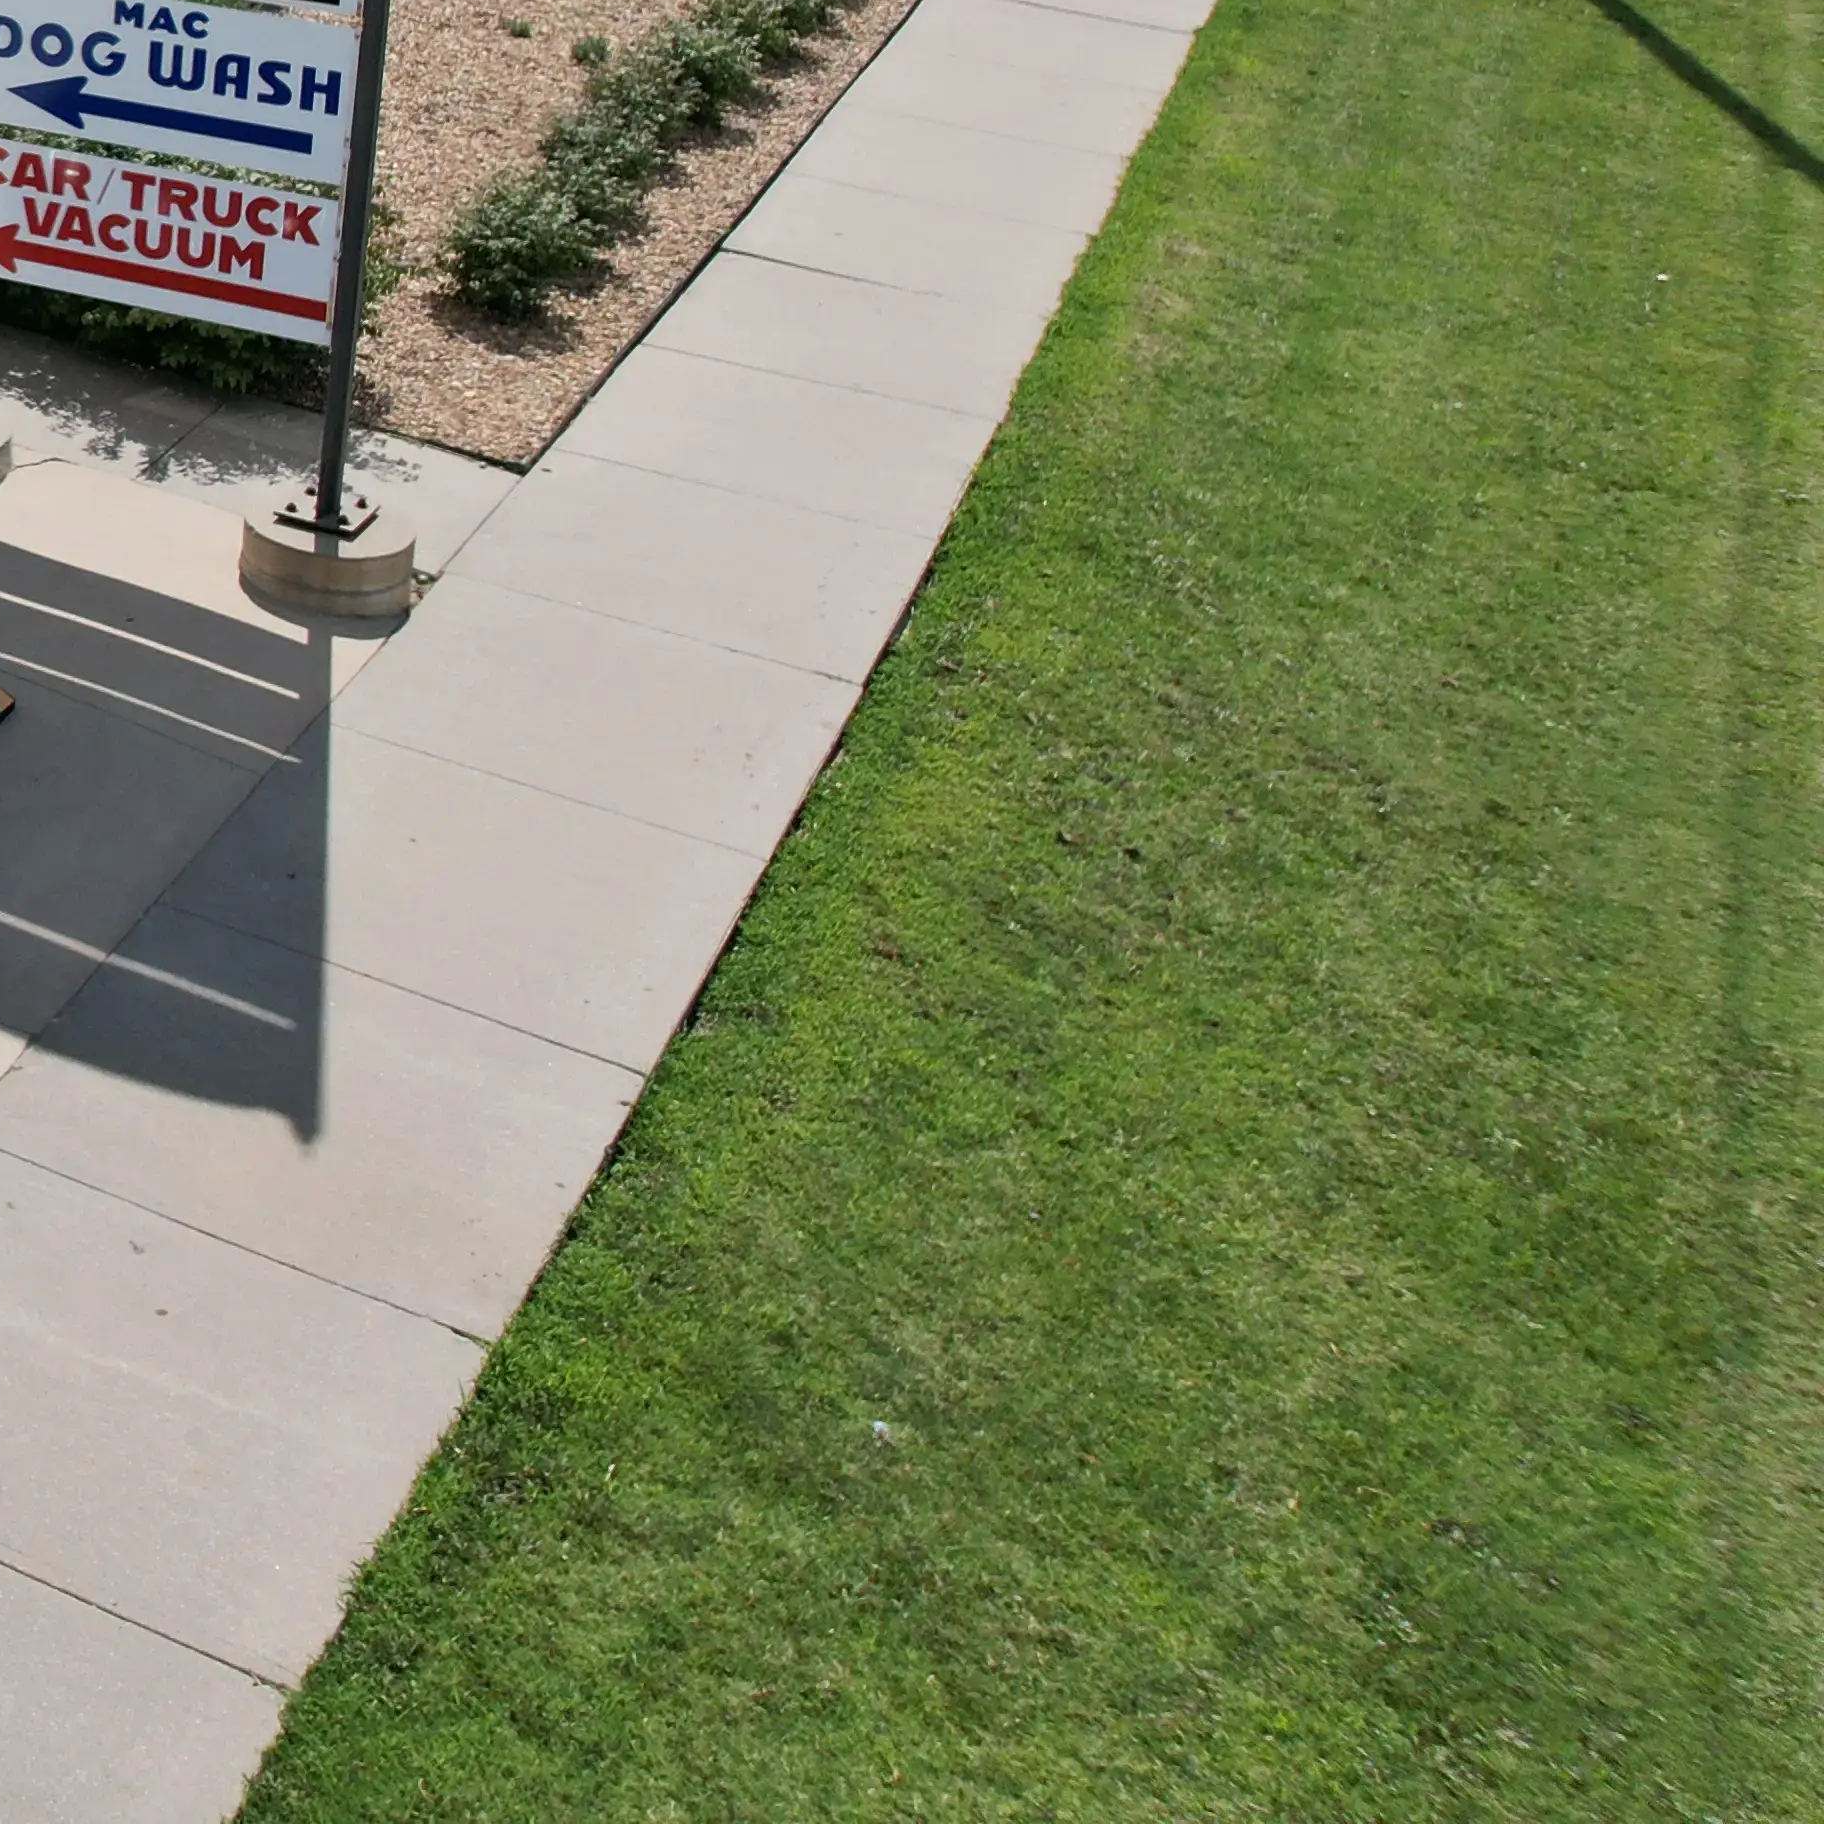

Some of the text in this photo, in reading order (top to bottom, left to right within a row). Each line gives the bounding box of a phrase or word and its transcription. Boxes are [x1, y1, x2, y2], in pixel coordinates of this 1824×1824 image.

[113, 0, 211, 39] MAC
[148, 40, 343, 116] WASH
[23, 197, 265, 281] VACUUM
